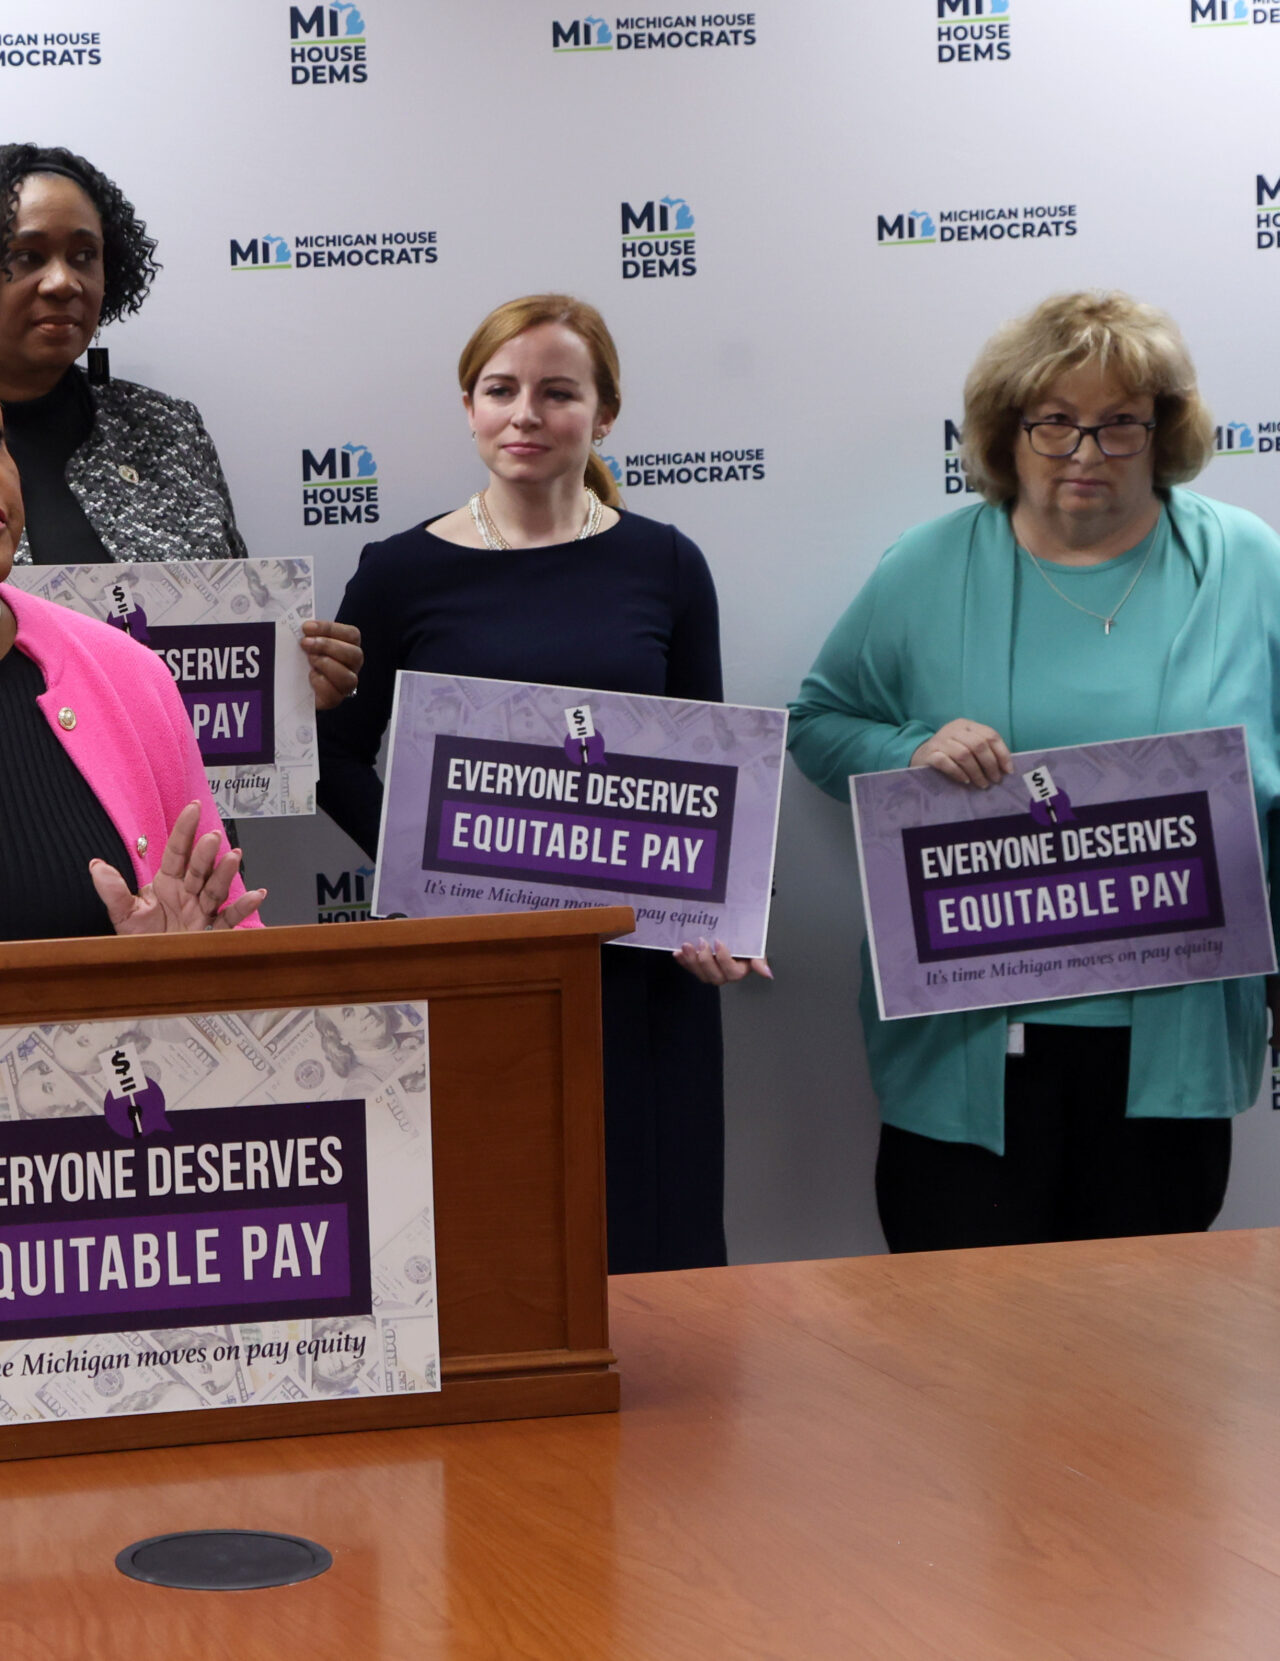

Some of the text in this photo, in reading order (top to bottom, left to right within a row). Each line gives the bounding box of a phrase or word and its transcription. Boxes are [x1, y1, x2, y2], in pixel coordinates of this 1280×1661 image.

[290, 6, 338, 39] MI
[617, 14, 754, 29] MICHIGAN HOUSE
[938, 25, 1008, 41] HOUSE
[44, 33, 99, 45] HOUSE
[553, 21, 591, 47] MI
[617, 30, 755, 50] DEMOCRATS
[291, 46, 366, 63] HOUSE
[938, 42, 1010, 63] DEMS
[292, 64, 367, 84] DEMS
[622, 202, 668, 234] MI
[940, 205, 1076, 222] MICHIGAN HOUSE
[296, 232, 436, 247] MICHIGAN HOUSE
[878, 215, 914, 241] MI
[941, 221, 1076, 242] DEMOCRATS
[231, 239, 269, 266] MI
[296, 247, 437, 268] DEMOCRATS
[622, 240, 694, 258] HOUSE
[623, 258, 696, 279] DEMS
[303, 449, 350, 481] MI
[626, 449, 763, 467] MICHIGAN HOUSE
[627, 464, 764, 486] DEMOCRATS
[304, 487, 378, 504] HOUSE
[304, 505, 379, 525] DEMS
[158, 645, 260, 681] SERVES
[193, 701, 250, 739] PAY
[224, 774, 271, 794] equity
[448, 758, 718, 817] EVERYONE DESERVES
[453, 813, 703, 873] EQUITABLE PAY
[922, 815, 1196, 878] EVERYONE DESERVES
[319, 872, 365, 905] MI
[450, 882, 484, 899] time
[488, 886, 560, 910] Michigan
[636, 908, 670, 925] pay
[669, 909, 719, 931] equity
[939, 870, 1189, 933] EQUITABLE PAY
[952, 967, 986, 984] time
[989, 958, 1063, 978] Michigan
[1067, 954, 1114, 970] moves
[1118, 950, 1137, 964] on
[1141, 947, 1171, 966] pay
[1174, 939, 1224, 960] equity
[148, 1136, 342, 1196] DESERVES
[243, 1221, 328, 1280] PAY
[20, 1349, 131, 1377] Michigan
[136, 1344, 208, 1369] moves
[212, 1345, 242, 1364] on
[246, 1341, 291, 1365] pay
[293, 1331, 368, 1359] equity
